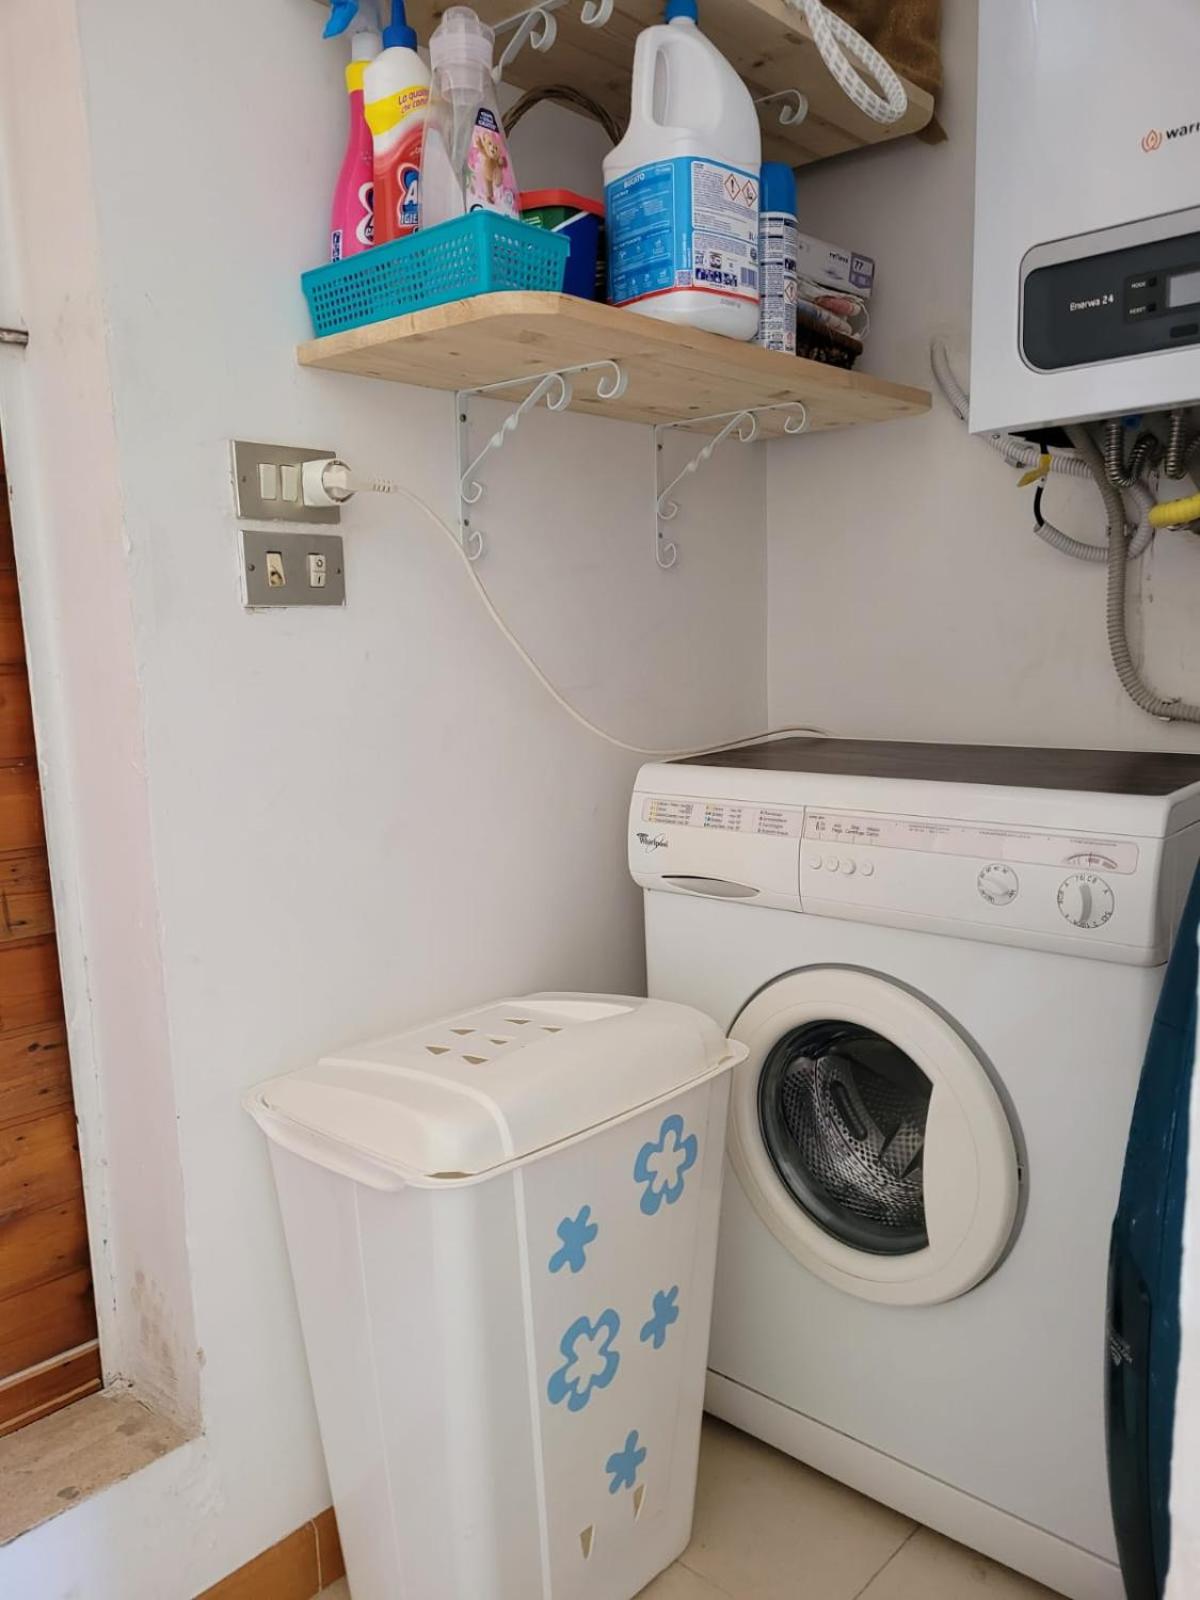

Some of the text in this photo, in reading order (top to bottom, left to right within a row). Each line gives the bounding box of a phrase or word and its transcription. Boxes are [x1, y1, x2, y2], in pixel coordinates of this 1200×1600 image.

[854, 259, 865, 272] 77
[1069, 293, 1114, 312] Enerwa 24
[636, 832, 669, 849] Whirlpool
